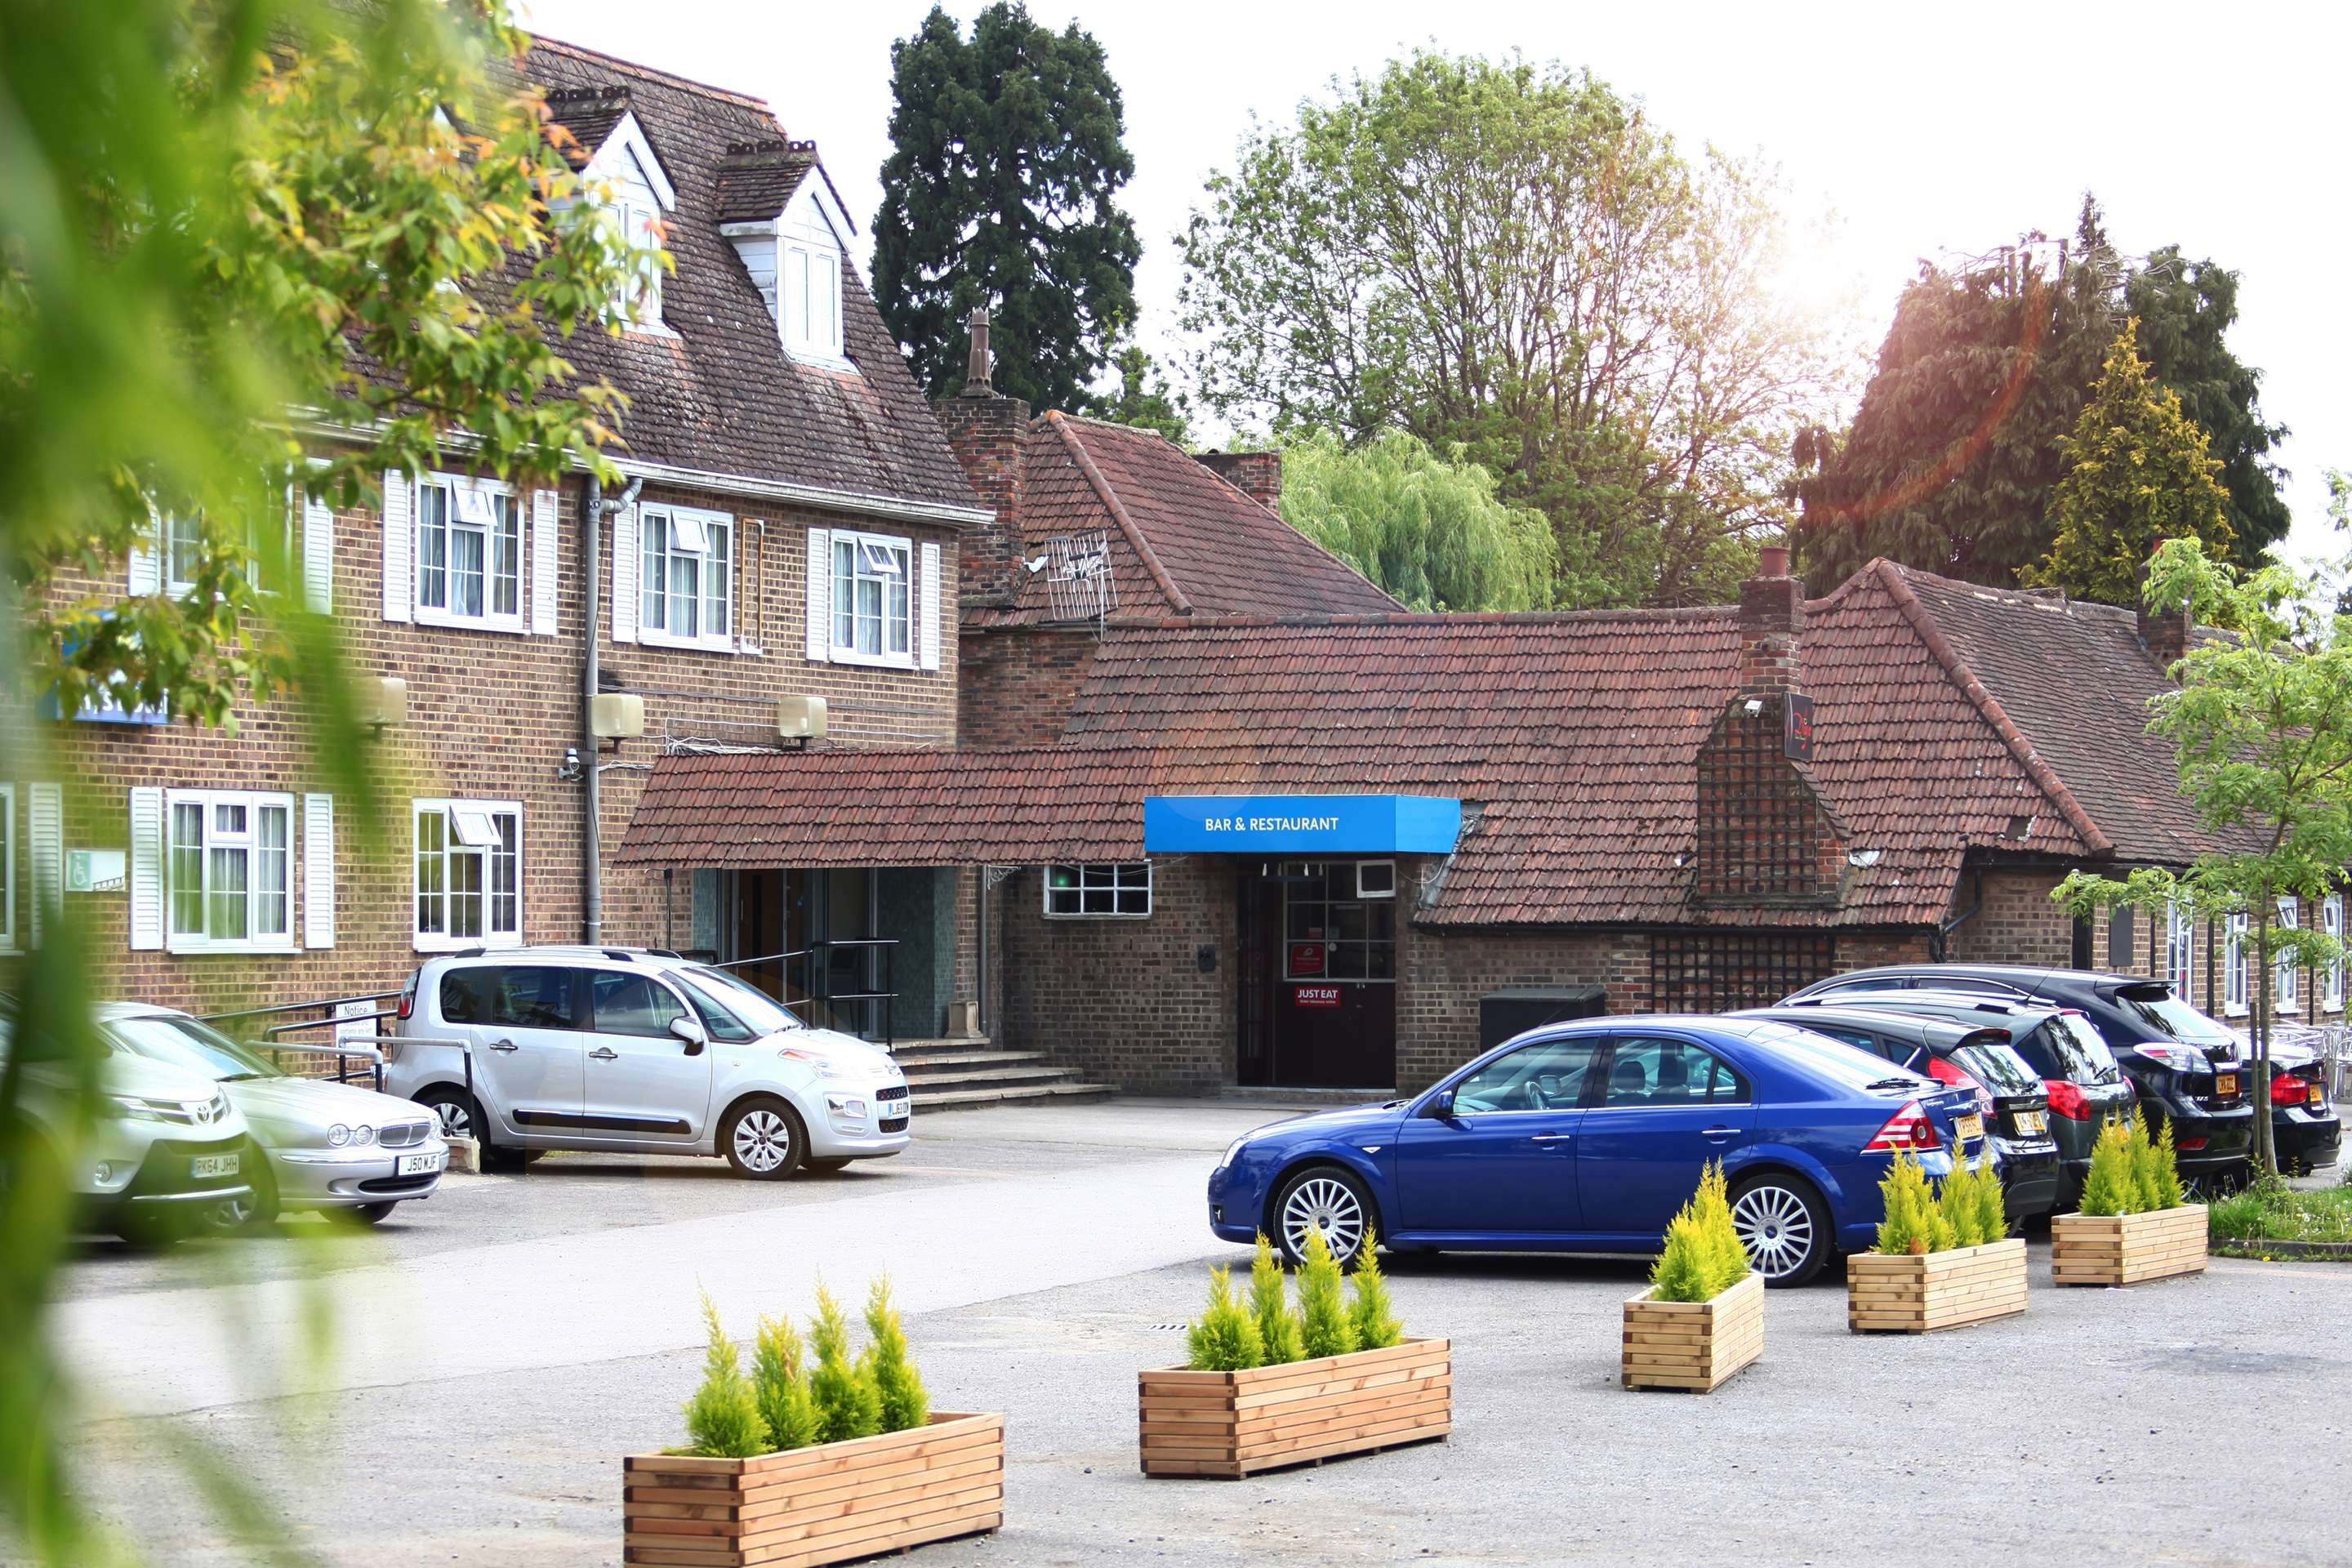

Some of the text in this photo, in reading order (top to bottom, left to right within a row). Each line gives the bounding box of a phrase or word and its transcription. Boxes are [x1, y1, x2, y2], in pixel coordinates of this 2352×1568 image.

[1205, 817, 1339, 831] BAR & RESTAURANT
[1298, 989, 1339, 999] JUST EAT
[344, 1004, 368, 1017] Notice
